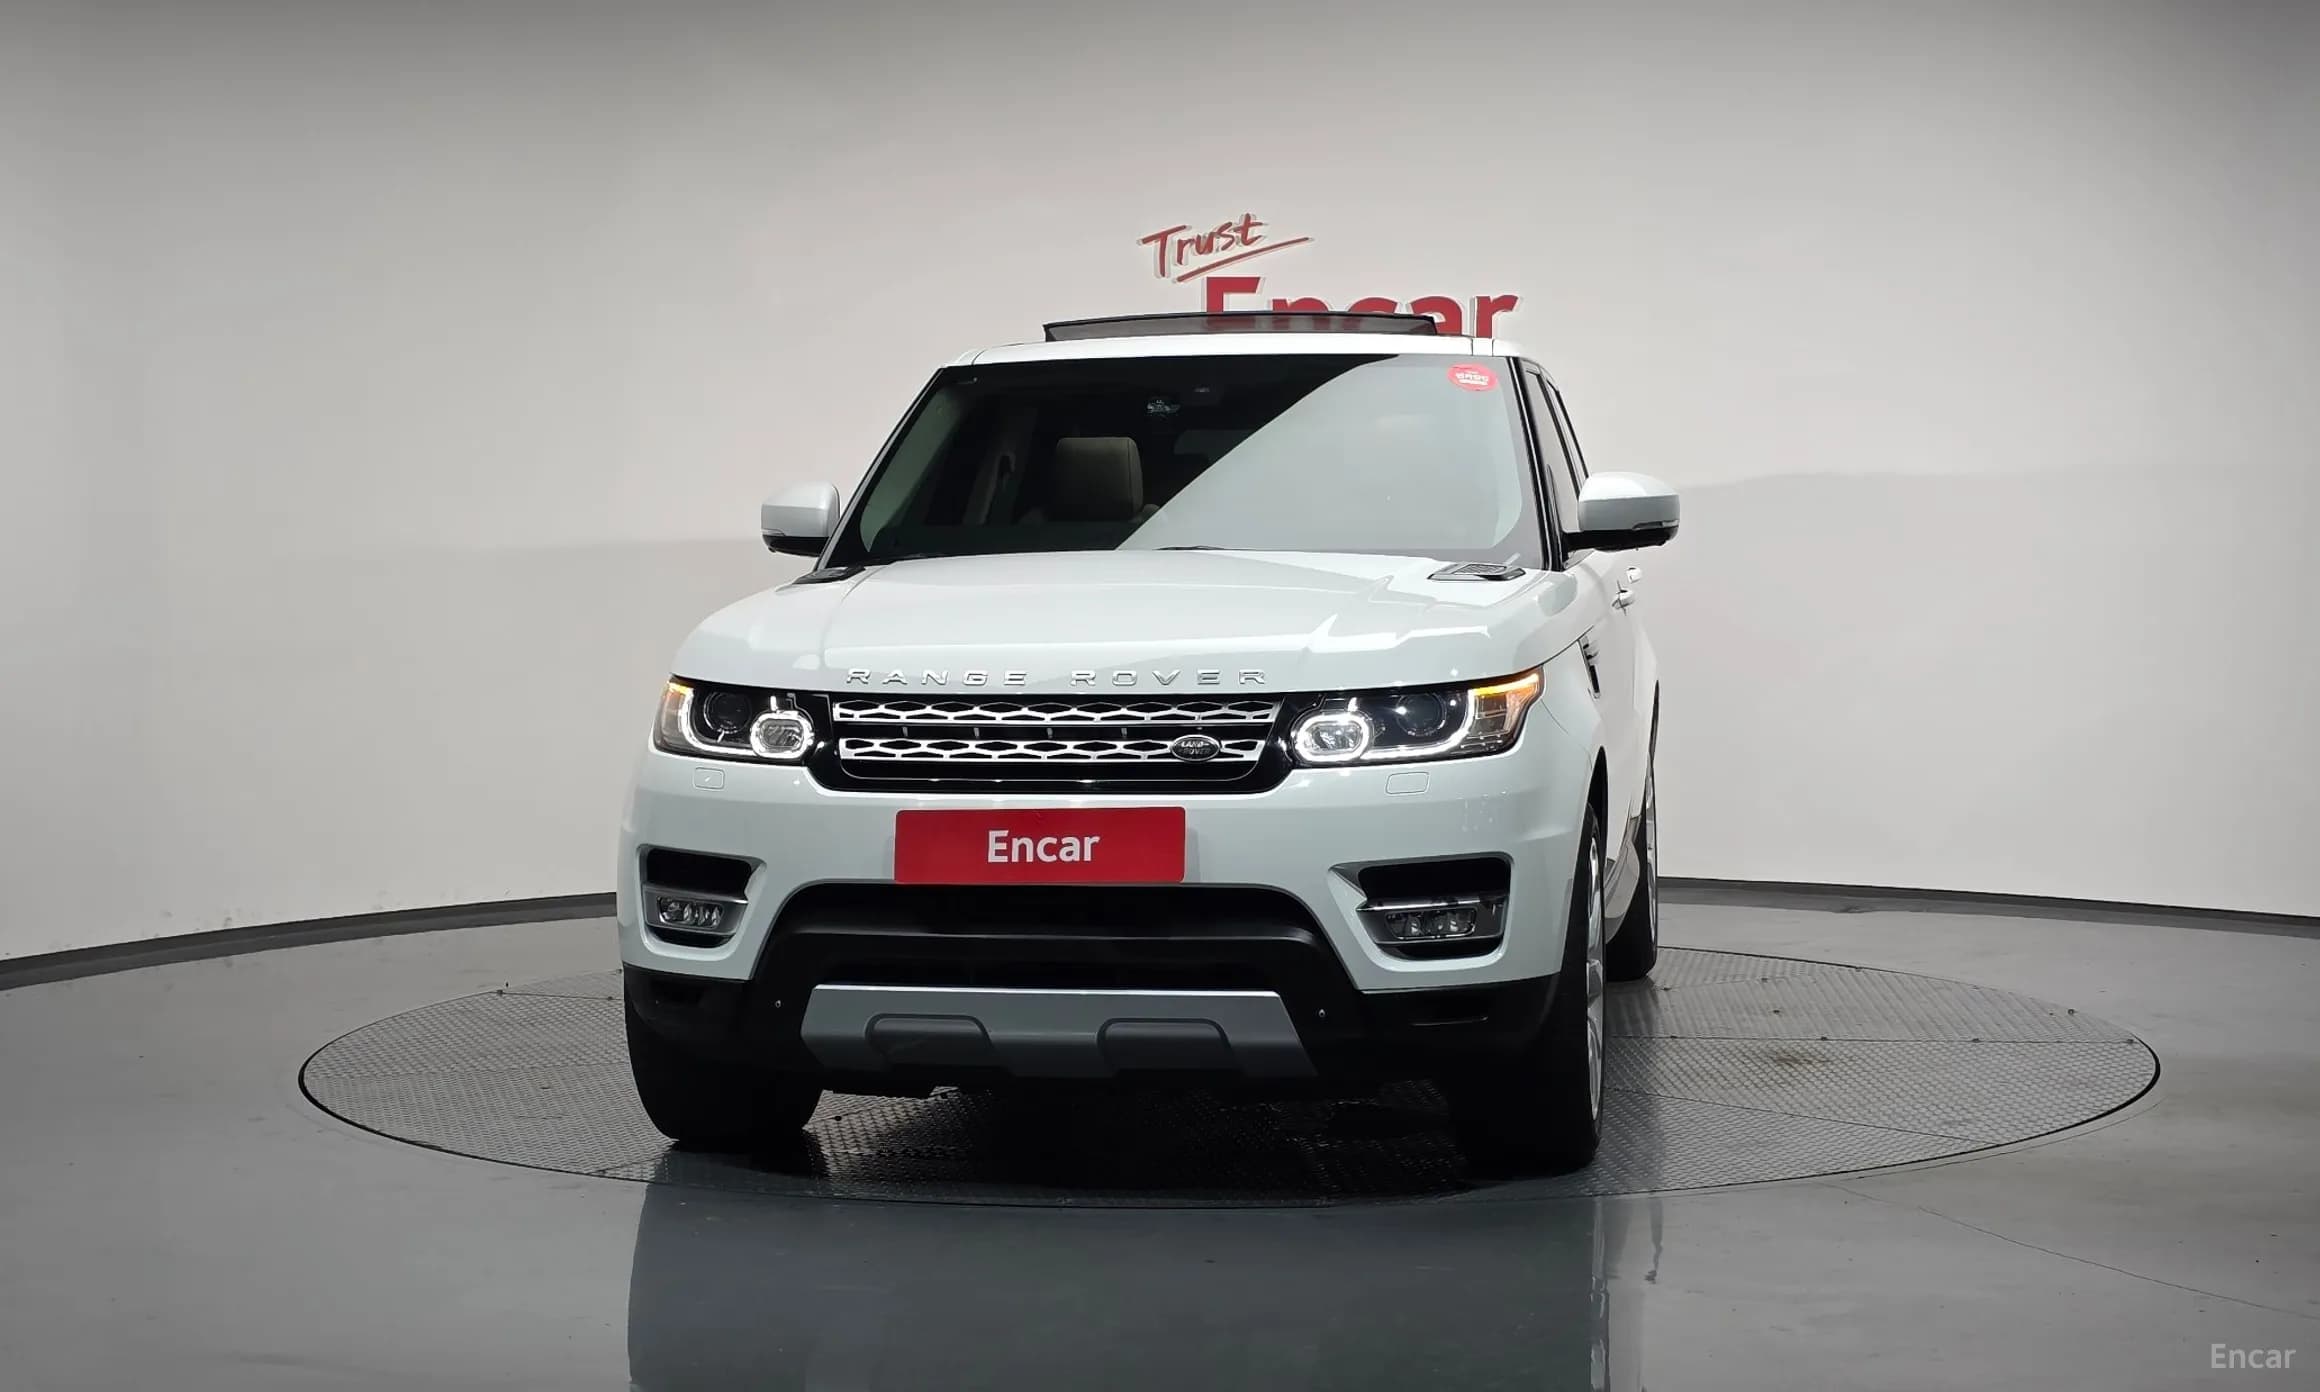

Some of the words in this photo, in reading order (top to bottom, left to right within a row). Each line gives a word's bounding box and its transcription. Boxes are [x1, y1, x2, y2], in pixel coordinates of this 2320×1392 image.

[1141, 213, 1264, 278] Trust
[845, 667, 1027, 686] RANGE
[1070, 668, 1266, 686] ROVER
[986, 829, 1100, 863] Encar
